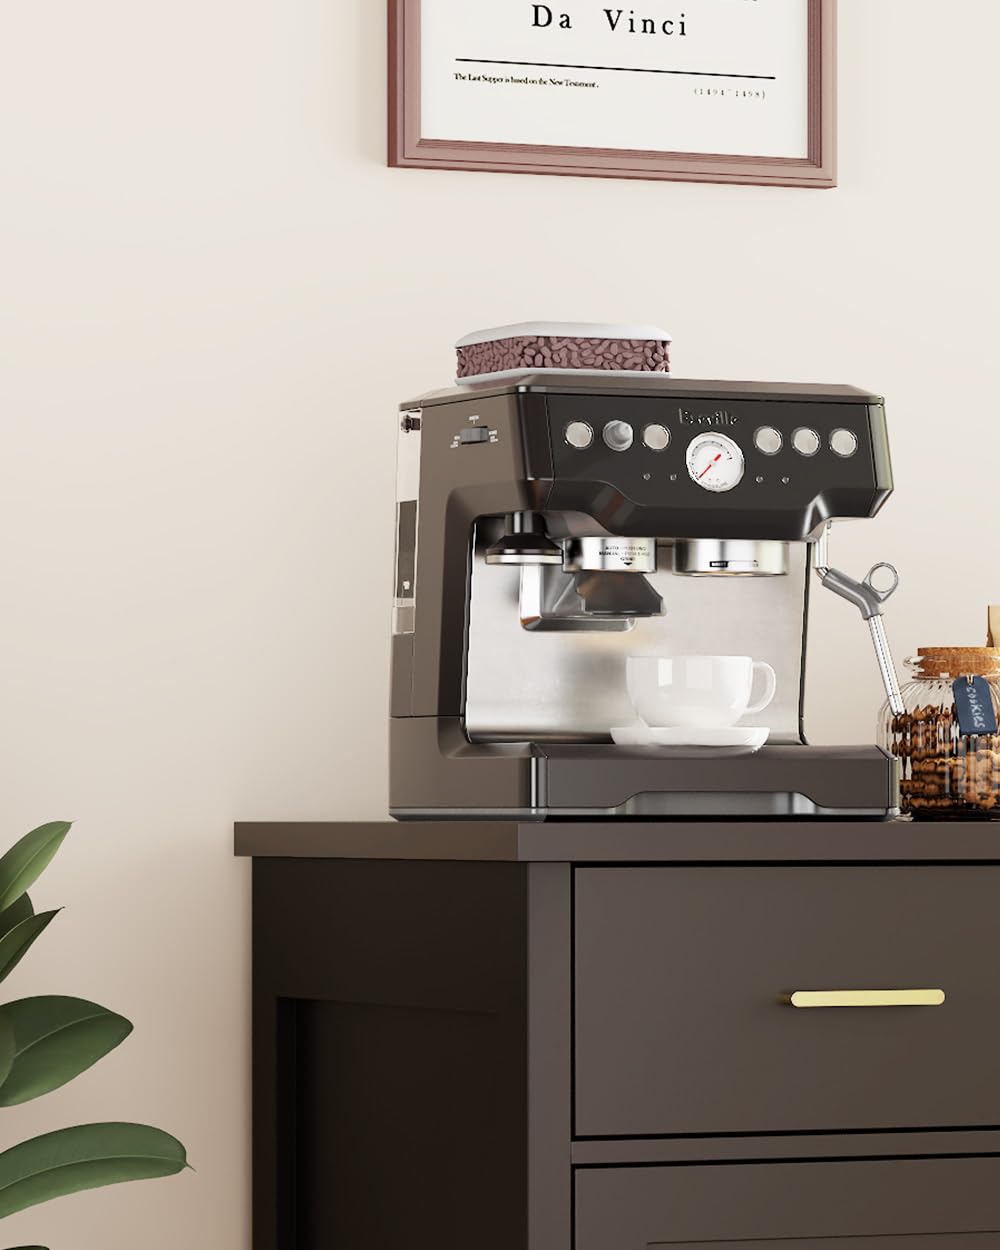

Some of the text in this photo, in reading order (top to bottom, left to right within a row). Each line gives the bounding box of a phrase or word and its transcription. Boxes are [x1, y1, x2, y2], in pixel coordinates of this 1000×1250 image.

[531, 4, 687, 36] Da Vinci
[454, 73, 467, 81] The
[468, 73, 481, 81] Last
[481, 75, 503, 84] Supper
[539, 77, 548, 85] the
